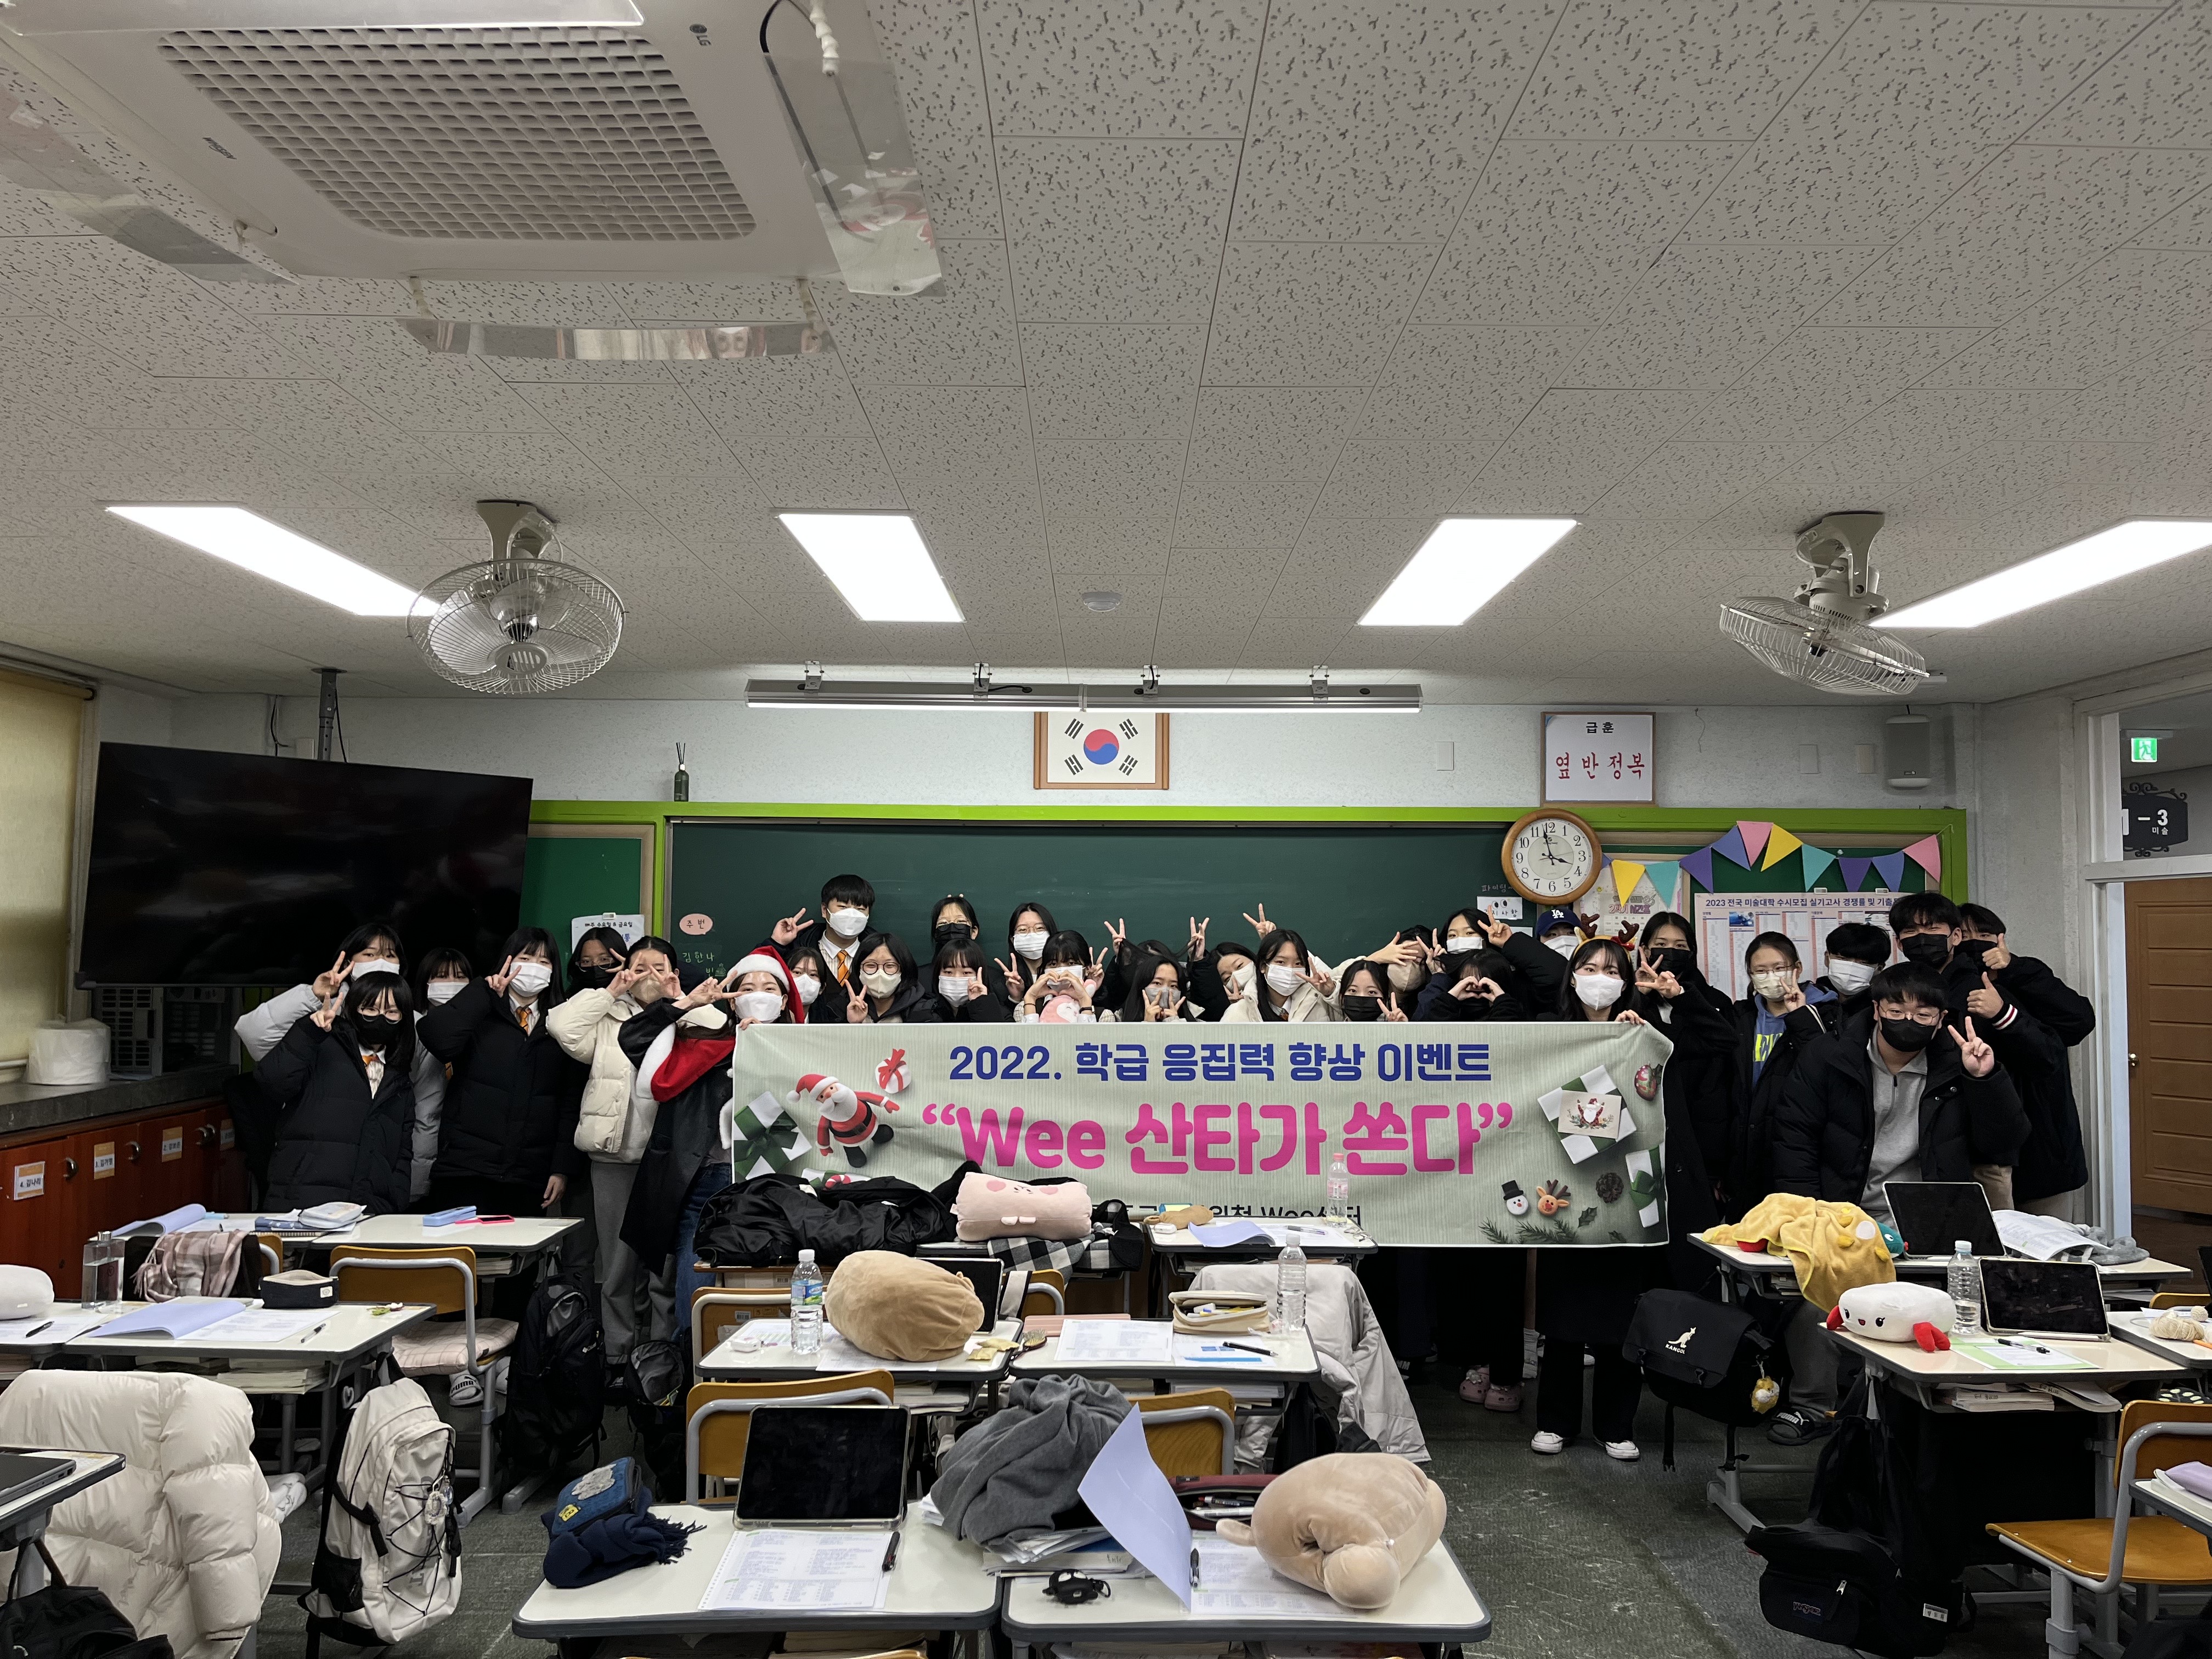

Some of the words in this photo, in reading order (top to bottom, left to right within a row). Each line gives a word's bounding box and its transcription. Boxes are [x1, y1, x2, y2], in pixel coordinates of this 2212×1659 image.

[1585, 721, 1614, 734] 급훈
[1530, 826, 1539, 838] 11
[1544, 822, 1555, 833] 12
[1562, 825, 1567, 836] 1
[1520, 837, 1530, 848] 10
[1573, 835, 1581, 847] 2
[1516, 852, 1523, 864] 9
[1578, 850, 1586, 862] 3
[1521, 867, 1529, 878] 8
[1573, 866, 1582, 877] 4
[1533, 878, 1541, 889] 7
[1549, 881, 1556, 893] 6
[1564, 877, 1571, 889] 5
[1728, 899, 1742, 907] 전국
[1745, 899, 1775, 907] 미술대학
[1777, 898, 1807, 907] 수시모집
[1810, 898, 1840, 906] 실기고사
[1843, 898, 1865, 906] 경쟁률
[1867, 898, 1875, 906] 및
[1552, 909, 1564, 919] LA
[686, 919, 705, 929] 주번
[950, 1046, 1061, 1080] 2022.
[1076, 1043, 1149, 1081] 학급
[1163, 1044, 1274, 1081] 응집력
[1289, 1042, 1365, 1081] 향상
[1378, 1044, 1491, 1081] 이벤트
[1125, 1102, 1327, 1175] 산타가
[1665, 1344, 1685, 1355] KANGOL
